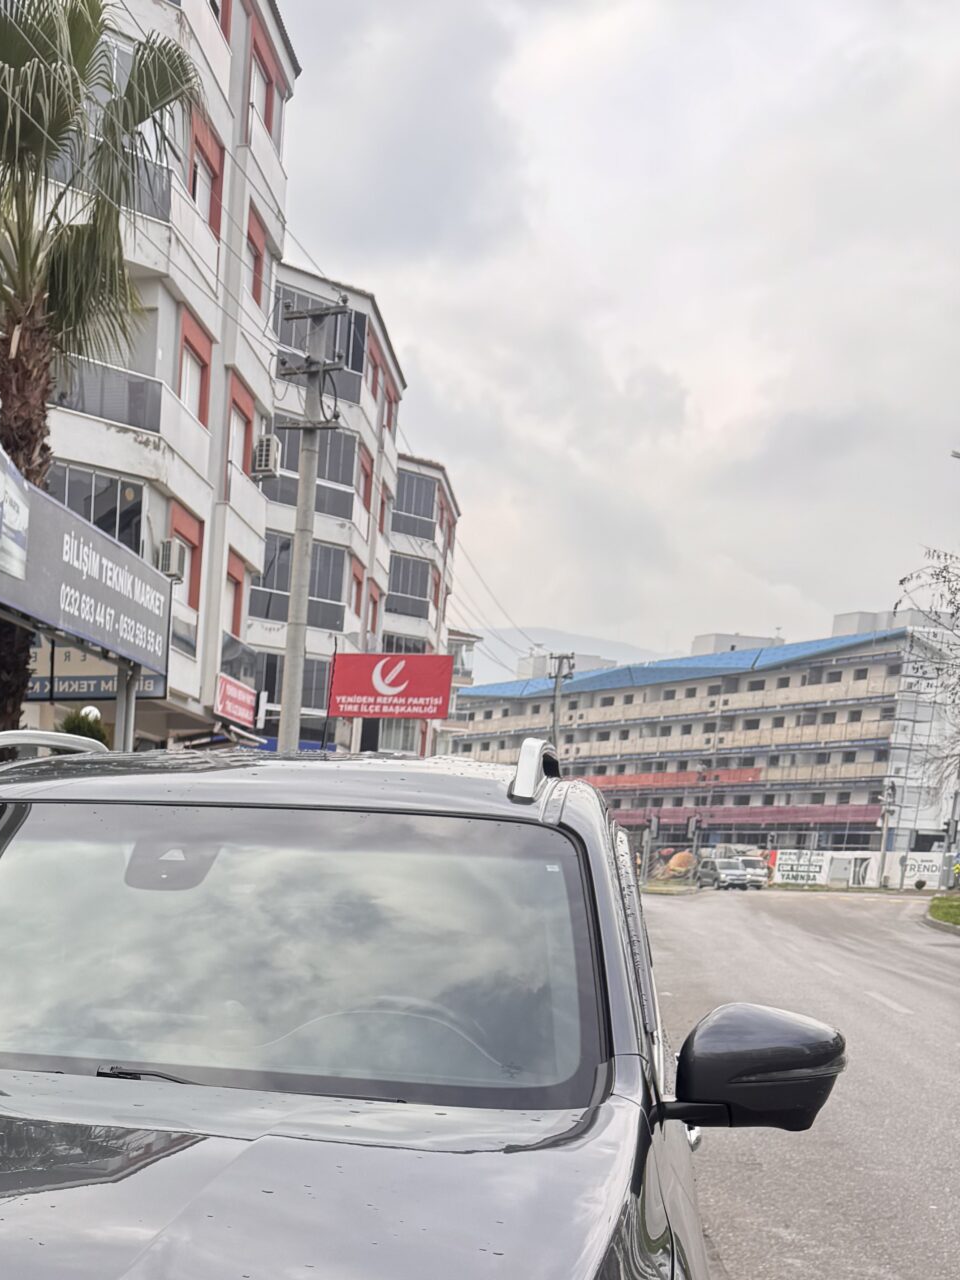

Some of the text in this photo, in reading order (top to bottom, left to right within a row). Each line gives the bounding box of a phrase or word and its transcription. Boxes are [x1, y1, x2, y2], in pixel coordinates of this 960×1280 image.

[62, 531, 165, 617] BİLİŞİM TEKNİK MARKET
[60, 582, 80, 616] 0232
[80, 594, 95, 623] 683
[95, 602, 105, 628] 44
[106, 606, 115, 632] 67
[119, 614, 135, 642] 0532
[147, 628, 155, 653] 55
[155, 634, 163, 657] 43
[335, 694, 443, 705] YENİDEN REFAH PARTİSİ
[360, 703, 381, 714] İLÇE
[381, 702, 438, 714] BAŞKANLIĞI
